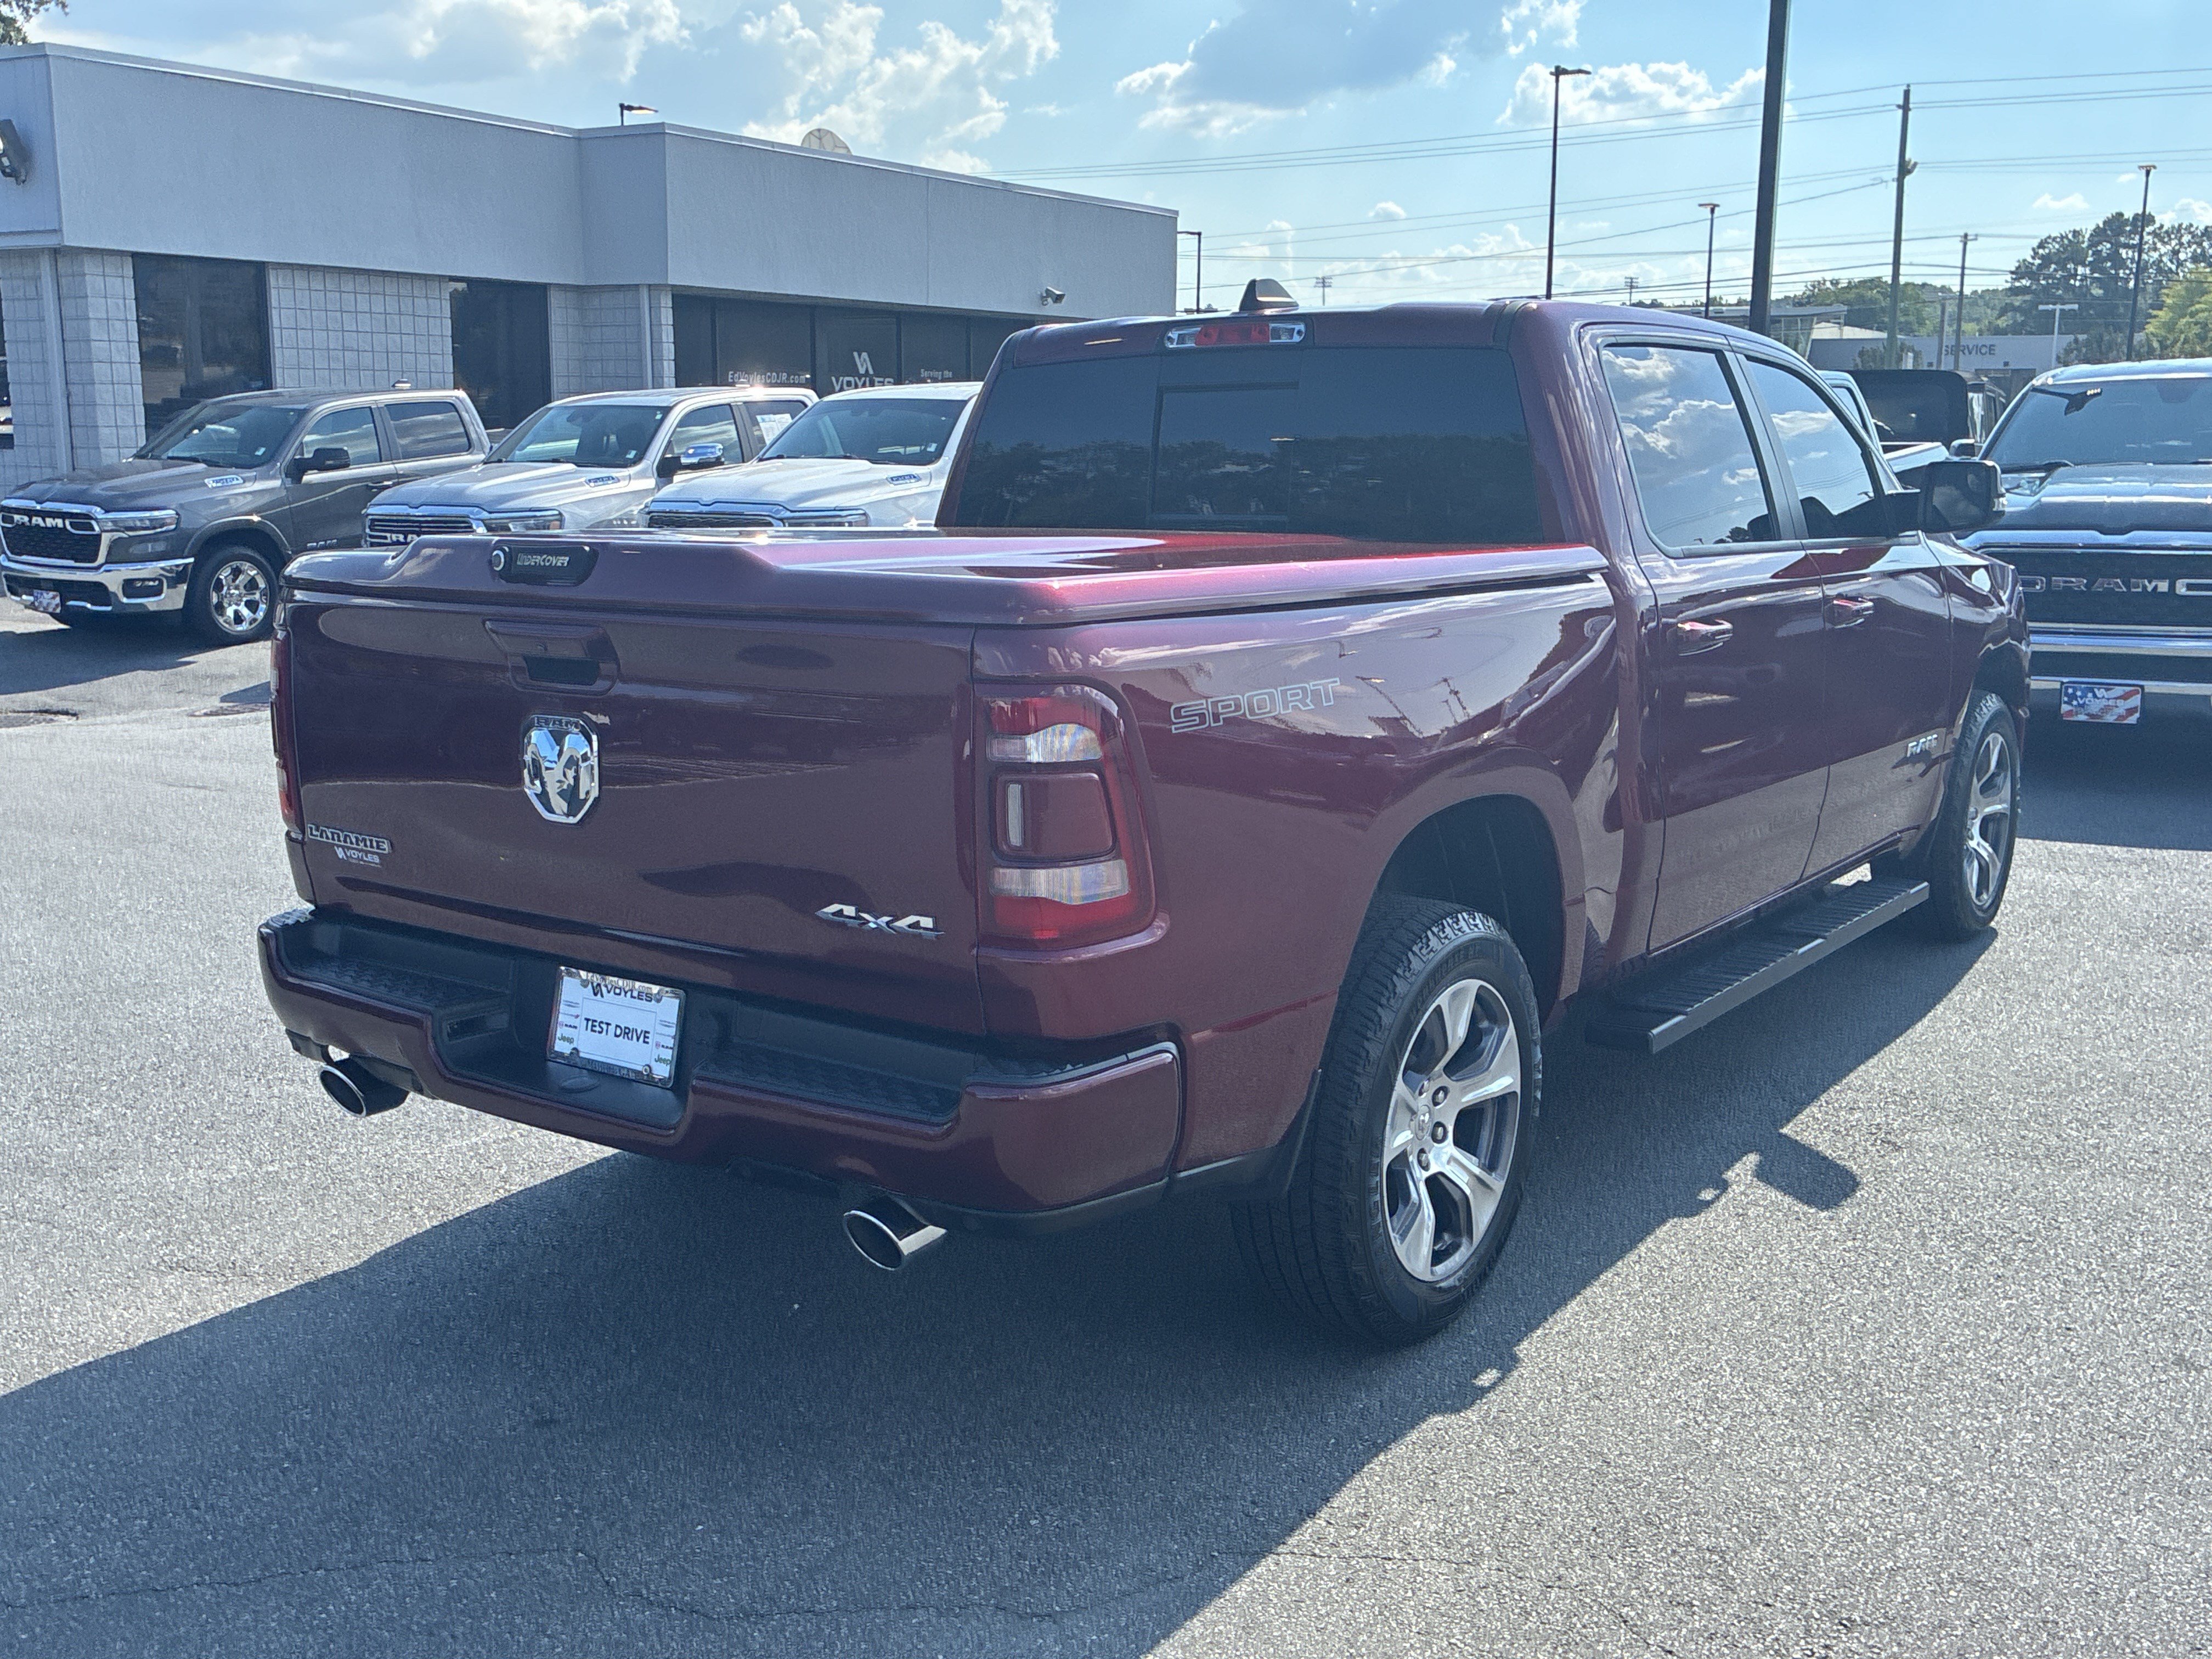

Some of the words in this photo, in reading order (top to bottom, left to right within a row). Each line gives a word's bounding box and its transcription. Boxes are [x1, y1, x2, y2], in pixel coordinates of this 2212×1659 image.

[1944, 343, 1996, 356] SERVICE
[14, 515, 64, 528] RAM
[391, 533, 421, 543] RA
[516, 552, 571, 567] UNDERCOVER
[2051, 576, 2170, 593] RAM
[1170, 677, 1340, 733] SPORT
[534, 716, 581, 731] RAM
[307, 823, 392, 854] LARAMIE
[346, 848, 380, 864] VOYLES
[604, 983, 653, 1003] VOYLES
[557, 1032, 575, 1045] Jeep
[584, 1017, 612, 1036] TEST
[614, 1024, 651, 1045] DRIVE
